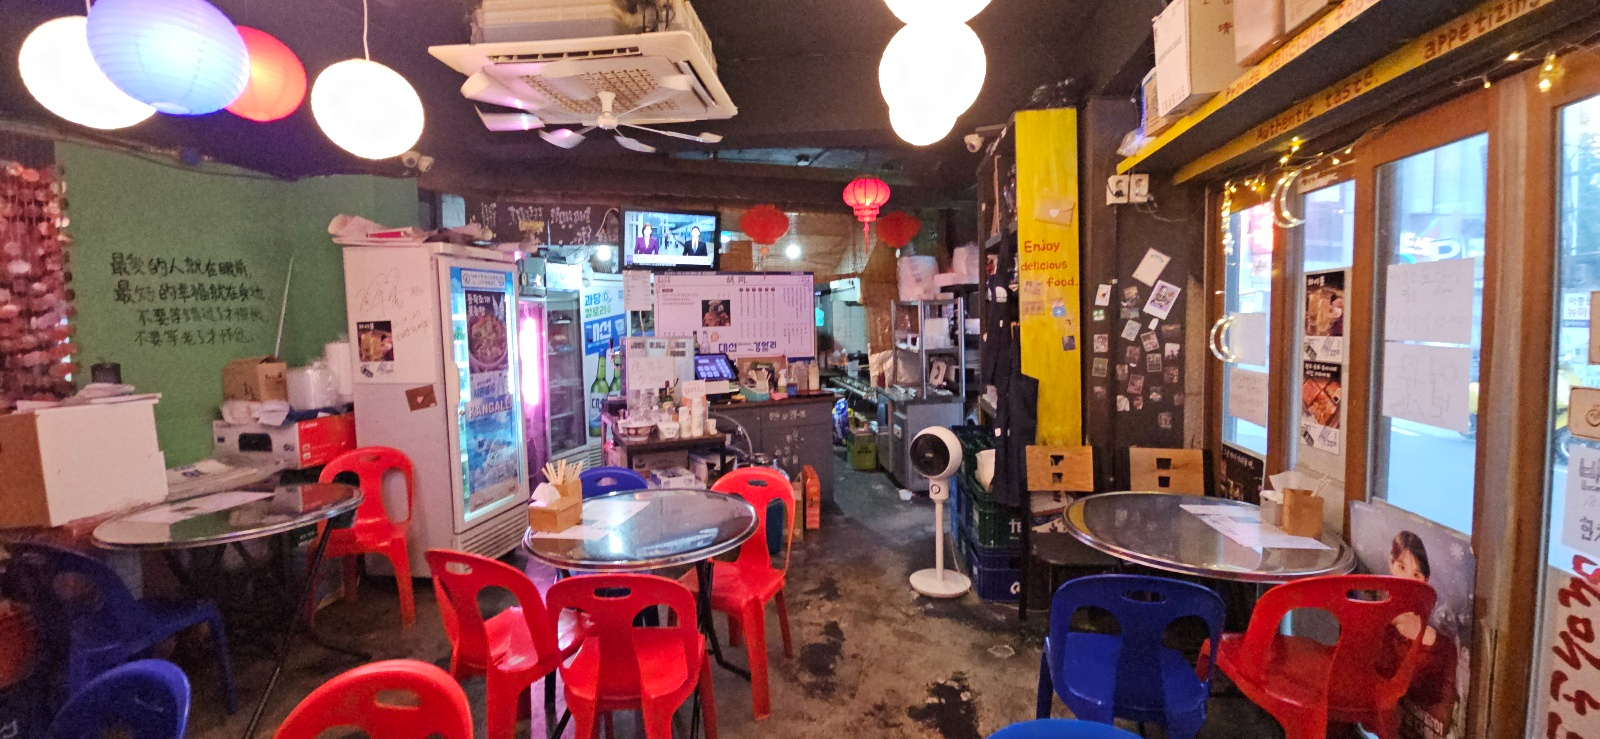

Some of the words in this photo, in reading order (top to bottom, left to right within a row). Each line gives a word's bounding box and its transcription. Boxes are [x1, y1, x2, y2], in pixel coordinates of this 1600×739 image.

[1225, 68, 1261, 98] Provide
[1266, 19, 1326, 72] delicious
[1257, 102, 1315, 140] Authentic
[1023, 239, 1060, 253] Enjoy
[1020, 260, 1068, 271] delicious
[1046, 277, 1079, 287] food.
[585, 293, 601, 306] 과당
[718, 342, 737, 353] 대선
